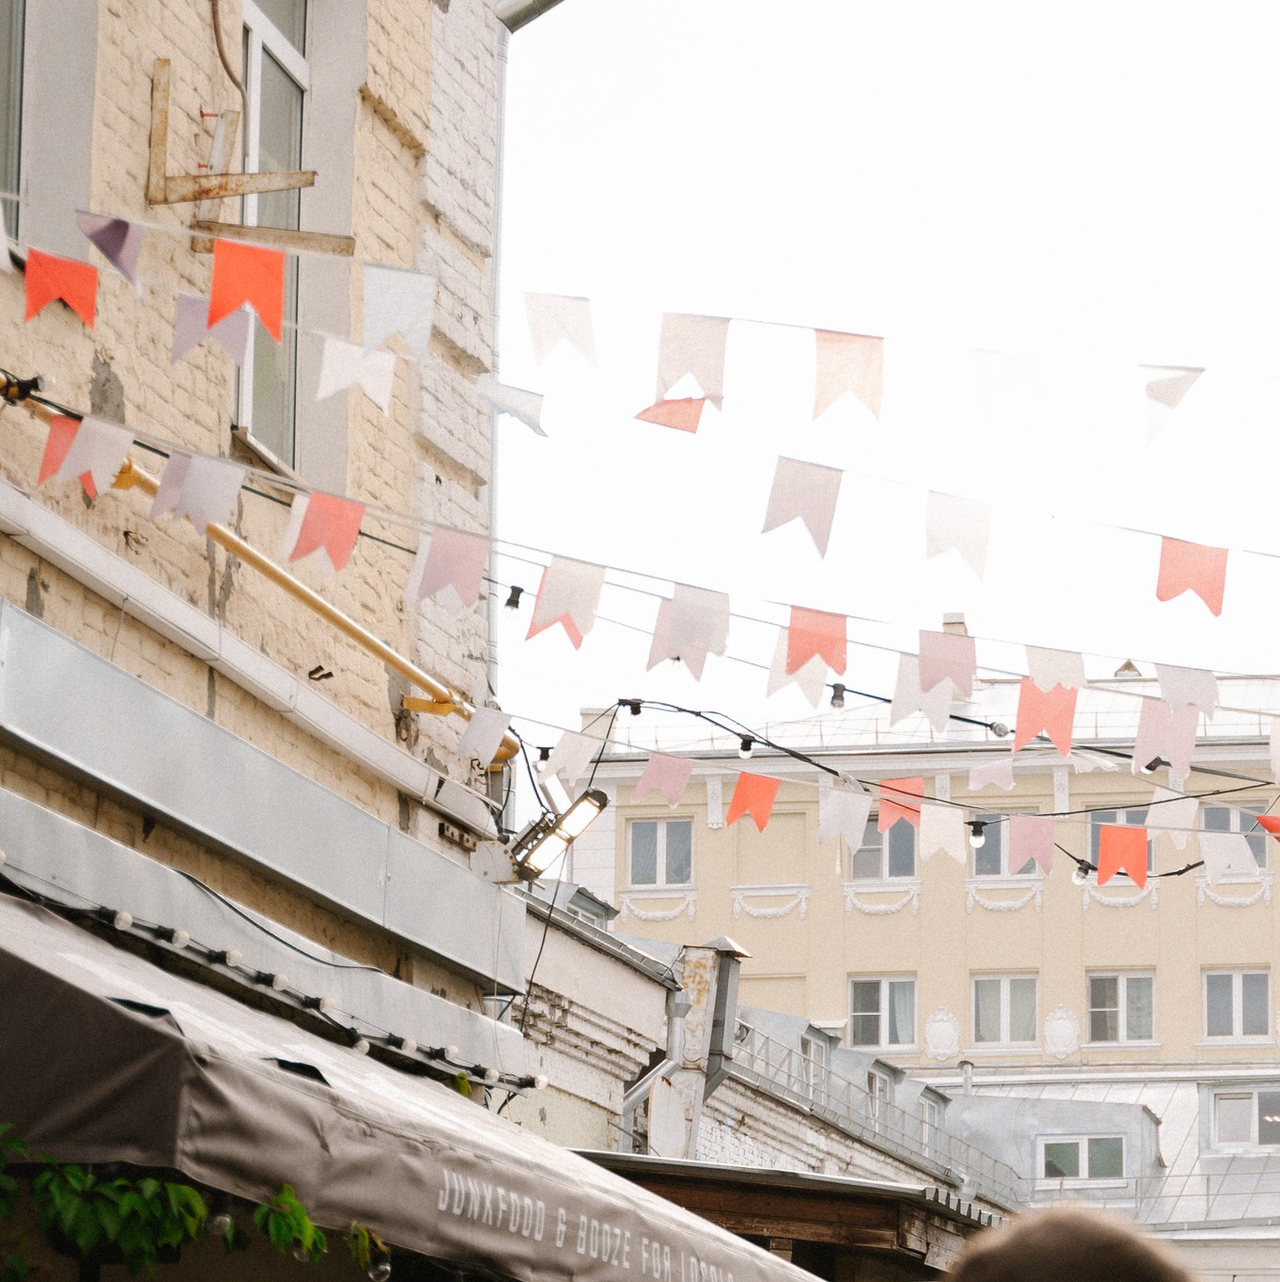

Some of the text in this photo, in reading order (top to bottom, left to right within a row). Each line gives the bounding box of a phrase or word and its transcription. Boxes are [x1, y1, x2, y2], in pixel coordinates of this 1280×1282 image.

[438, 1169, 545, 1242] JUNKFOOD
[556, 1207, 567, 1248] &
[577, 1215, 631, 1270] BOOZE
